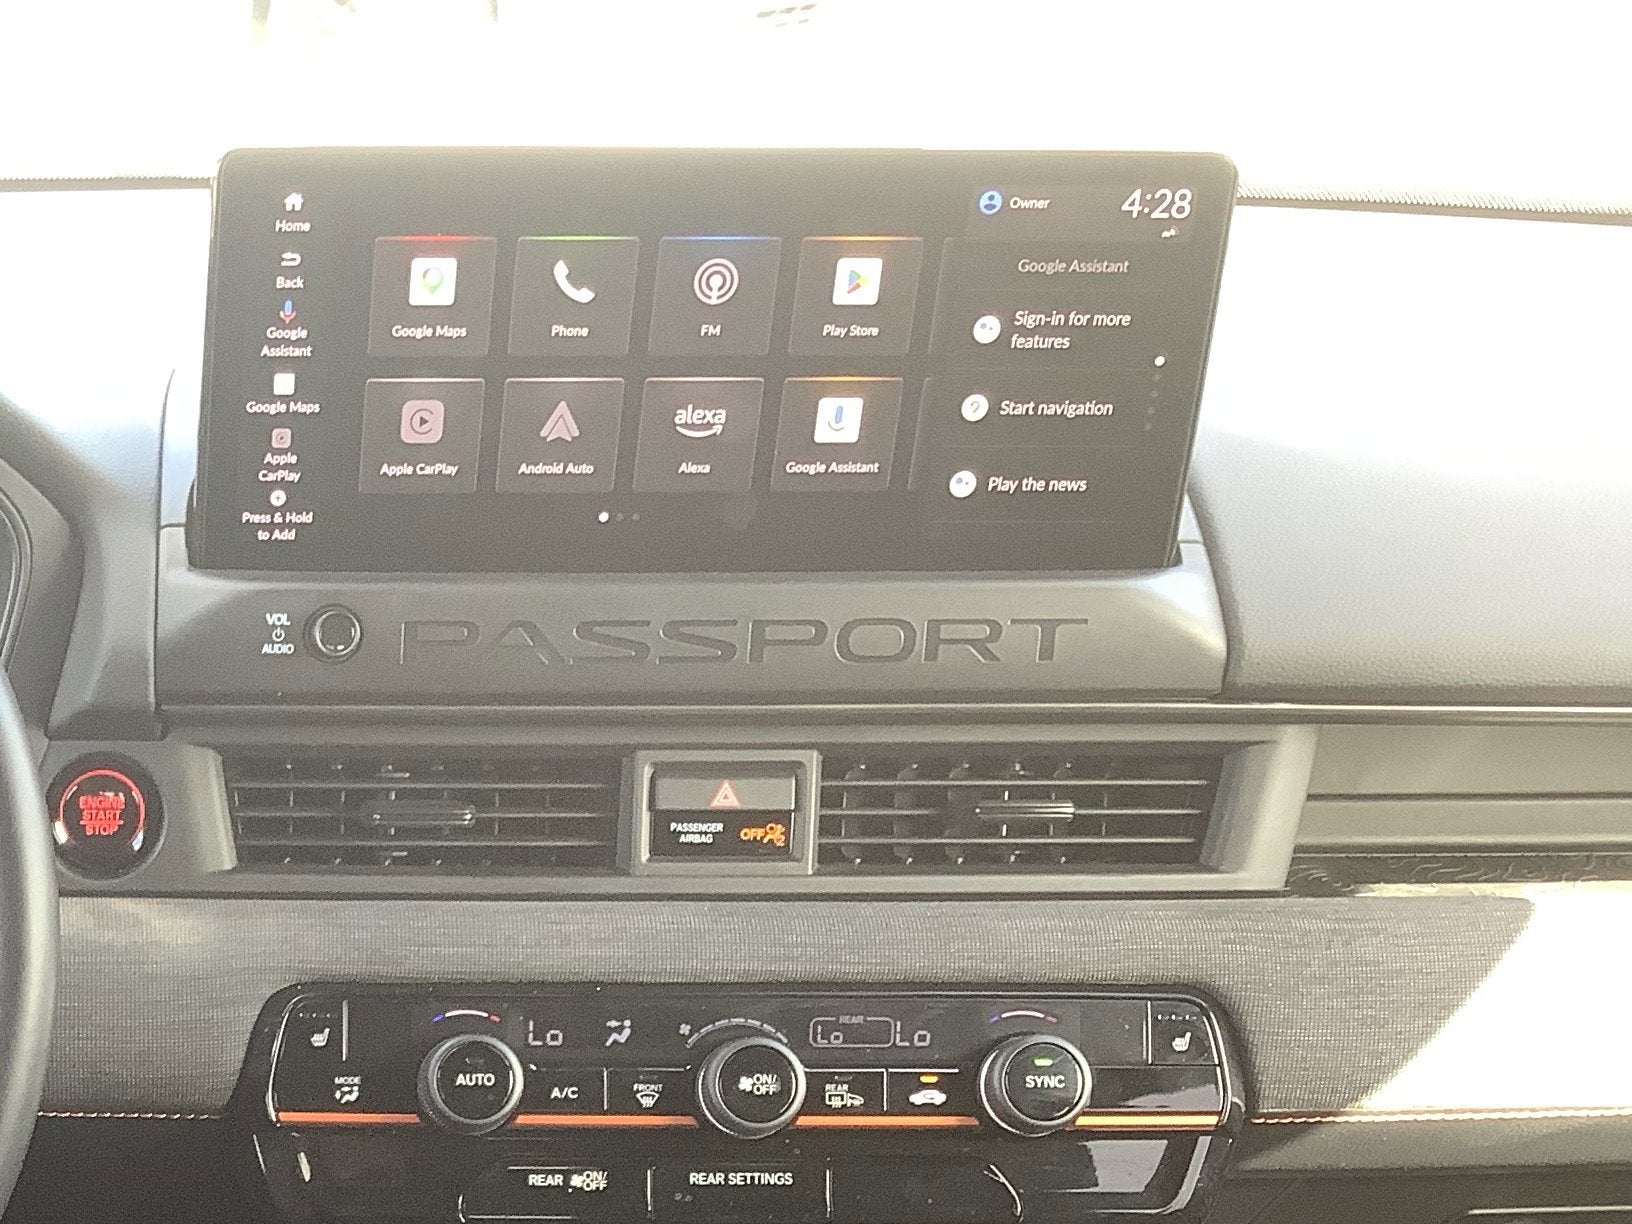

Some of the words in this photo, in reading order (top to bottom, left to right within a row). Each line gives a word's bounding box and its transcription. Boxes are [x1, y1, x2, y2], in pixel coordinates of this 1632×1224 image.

[1009, 197, 1050, 209] Owner
[1121, 188, 1193, 220] 4:28
[275, 220, 311, 232] Home
[1018, 259, 1067, 275] Google
[1069, 258, 1129, 274] Assistant
[276, 276, 304, 289] Back
[1014, 311, 1065, 330] Sign-in
[1068, 311, 1091, 327] for
[1094, 315, 1132, 327] more
[266, 327, 308, 341] Google
[391, 325, 433, 340] Google
[434, 325, 467, 339] Maps
[551, 324, 589, 339] Phone
[700, 325, 721, 337] FM
[823, 325, 848, 339] Play
[850, 325, 879, 336] Store
[1010, 333, 1071, 350] features
[260, 344, 312, 358] Assistant
[246, 401, 287, 415] Google
[289, 401, 320, 415] Maps
[674, 405, 726, 425] alexa
[999, 400, 1036, 416] Start
[1038, 400, 1114, 420] navigation
[264, 452, 297, 466] Apple
[380, 463, 414, 478] Apple
[415, 463, 459, 477] CarPlay
[518, 462, 564, 475] Android
[566, 462, 595, 475] Auto
[678, 462, 711, 474] Alexa
[785, 461, 826, 476] Google
[828, 461, 880, 474] Assistant
[258, 469, 301, 484] CarPlay
[987, 476, 1019, 495] Play
[1022, 476, 1046, 492] the
[1049, 479, 1088, 492] news
[242, 512, 272, 524] Press
[274, 512, 282, 524] &
[284, 512, 313, 524] Hold
[257, 530, 269, 540] to
[271, 529, 296, 540] Add
[266, 613, 290, 626] VOL
[261, 643, 294, 655] AUDIO
[400, 619, 1089, 666] PASSPORT
[79, 795, 126, 809] ENGINE
[82, 810, 122, 820] START
[85, 825, 118, 835] STOP
[670, 822, 724, 833] PASSENGER
[740, 828, 765, 841] OFF
[679, 834, 713, 844] AIRBAG
[456, 1073, 495, 1087] AUTO
[1025, 1075, 1065, 1089] SYNC
[550, 1086, 579, 1100] A/C
[633, 1083, 663, 1093] FRONT
[753, 1085, 777, 1095] OFF
[528, 1175, 563, 1186] REAR
[689, 1172, 725, 1186] REAR
[727, 1172, 794, 1186] SETTINGS
[583, 1181, 607, 1192] OFF
